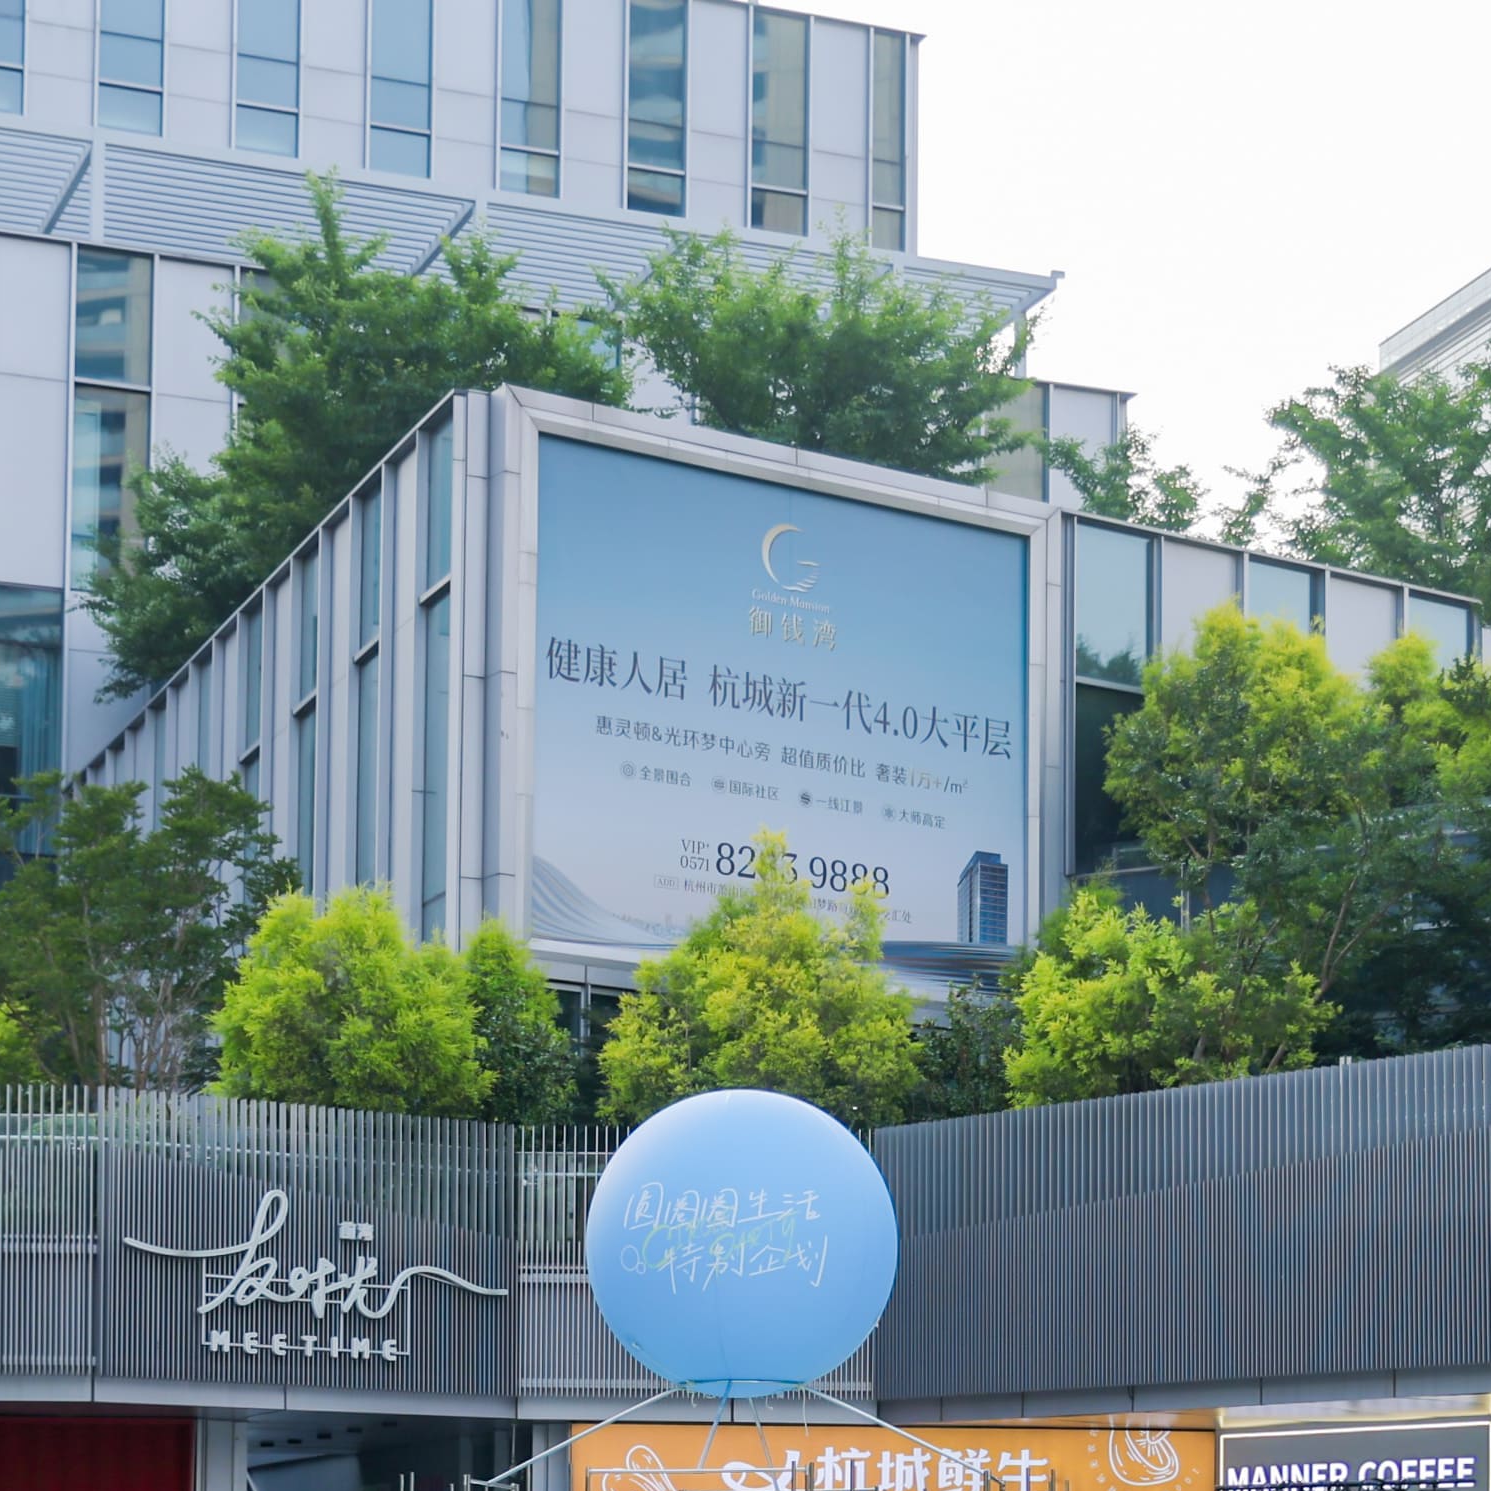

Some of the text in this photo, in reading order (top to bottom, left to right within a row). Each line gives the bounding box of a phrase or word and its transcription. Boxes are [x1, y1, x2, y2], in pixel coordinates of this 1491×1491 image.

[546, 636, 1012, 760] 健康人居 杭城新一代4.0大平层
[596, 715, 771, 763] 惠灵顿&光环梦中心旁
[780, 746, 867, 779] 超值质价比
[728, 780, 780, 801] 国际社区
[716, 842, 798, 884] 823
[209, 1329, 398, 1362] MEETIME
[1358, 1457, 1476, 1490] COFFEE
